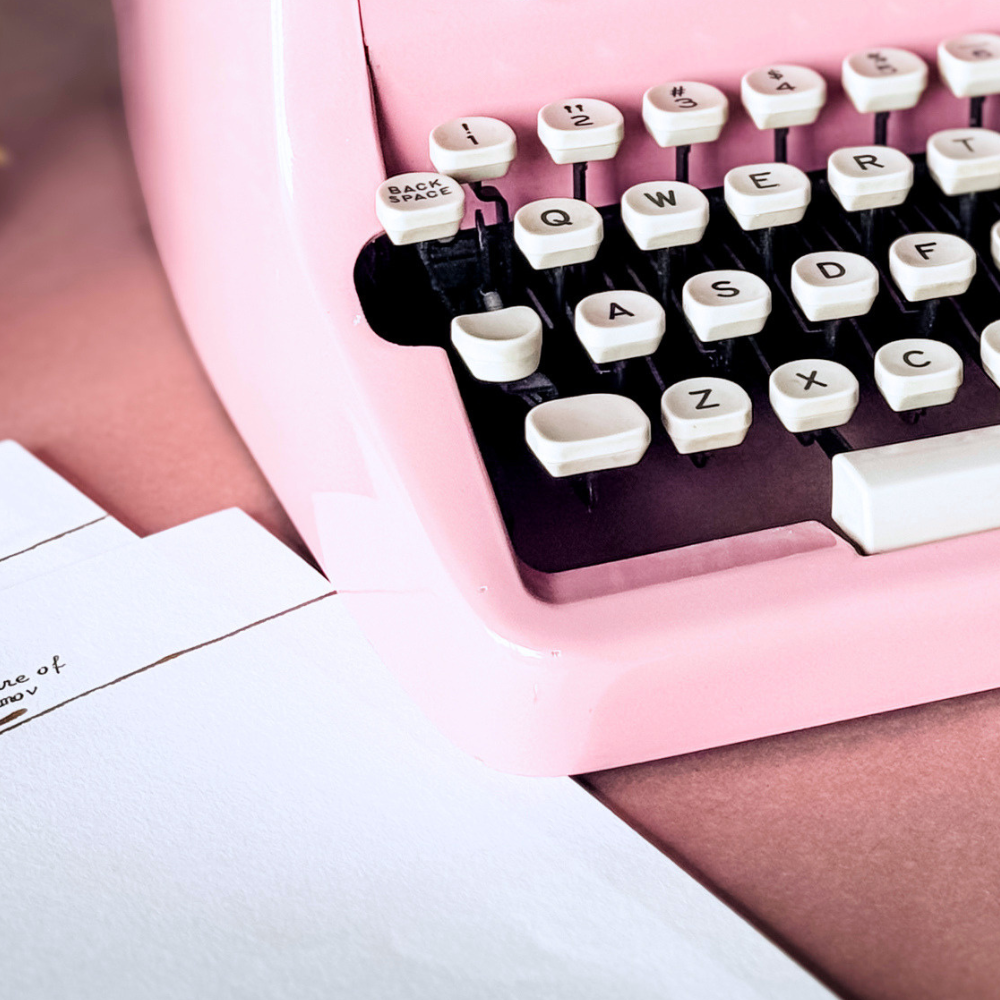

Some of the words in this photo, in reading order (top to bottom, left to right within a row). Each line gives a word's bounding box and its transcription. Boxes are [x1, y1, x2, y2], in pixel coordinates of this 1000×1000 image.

[675, 97, 699, 109] 3
[571, 115, 594, 127] 2
[951, 137, 976, 153] T
[853, 154, 885, 171] R
[388, 179, 442, 195] BACK
[748, 172, 781, 190] E
[388, 186, 453, 204] SPACE
[644, 190, 677, 208] W
[540, 209, 573, 227] Q
[914, 242, 938, 260] F
[816, 261, 846, 280] D
[711, 281, 740, 298] S
[608, 302, 635, 321] A
[902, 350, 932, 368] C
[796, 370, 828, 391] X
[689, 388, 720, 410] Z
[36, 654, 67, 675] of
